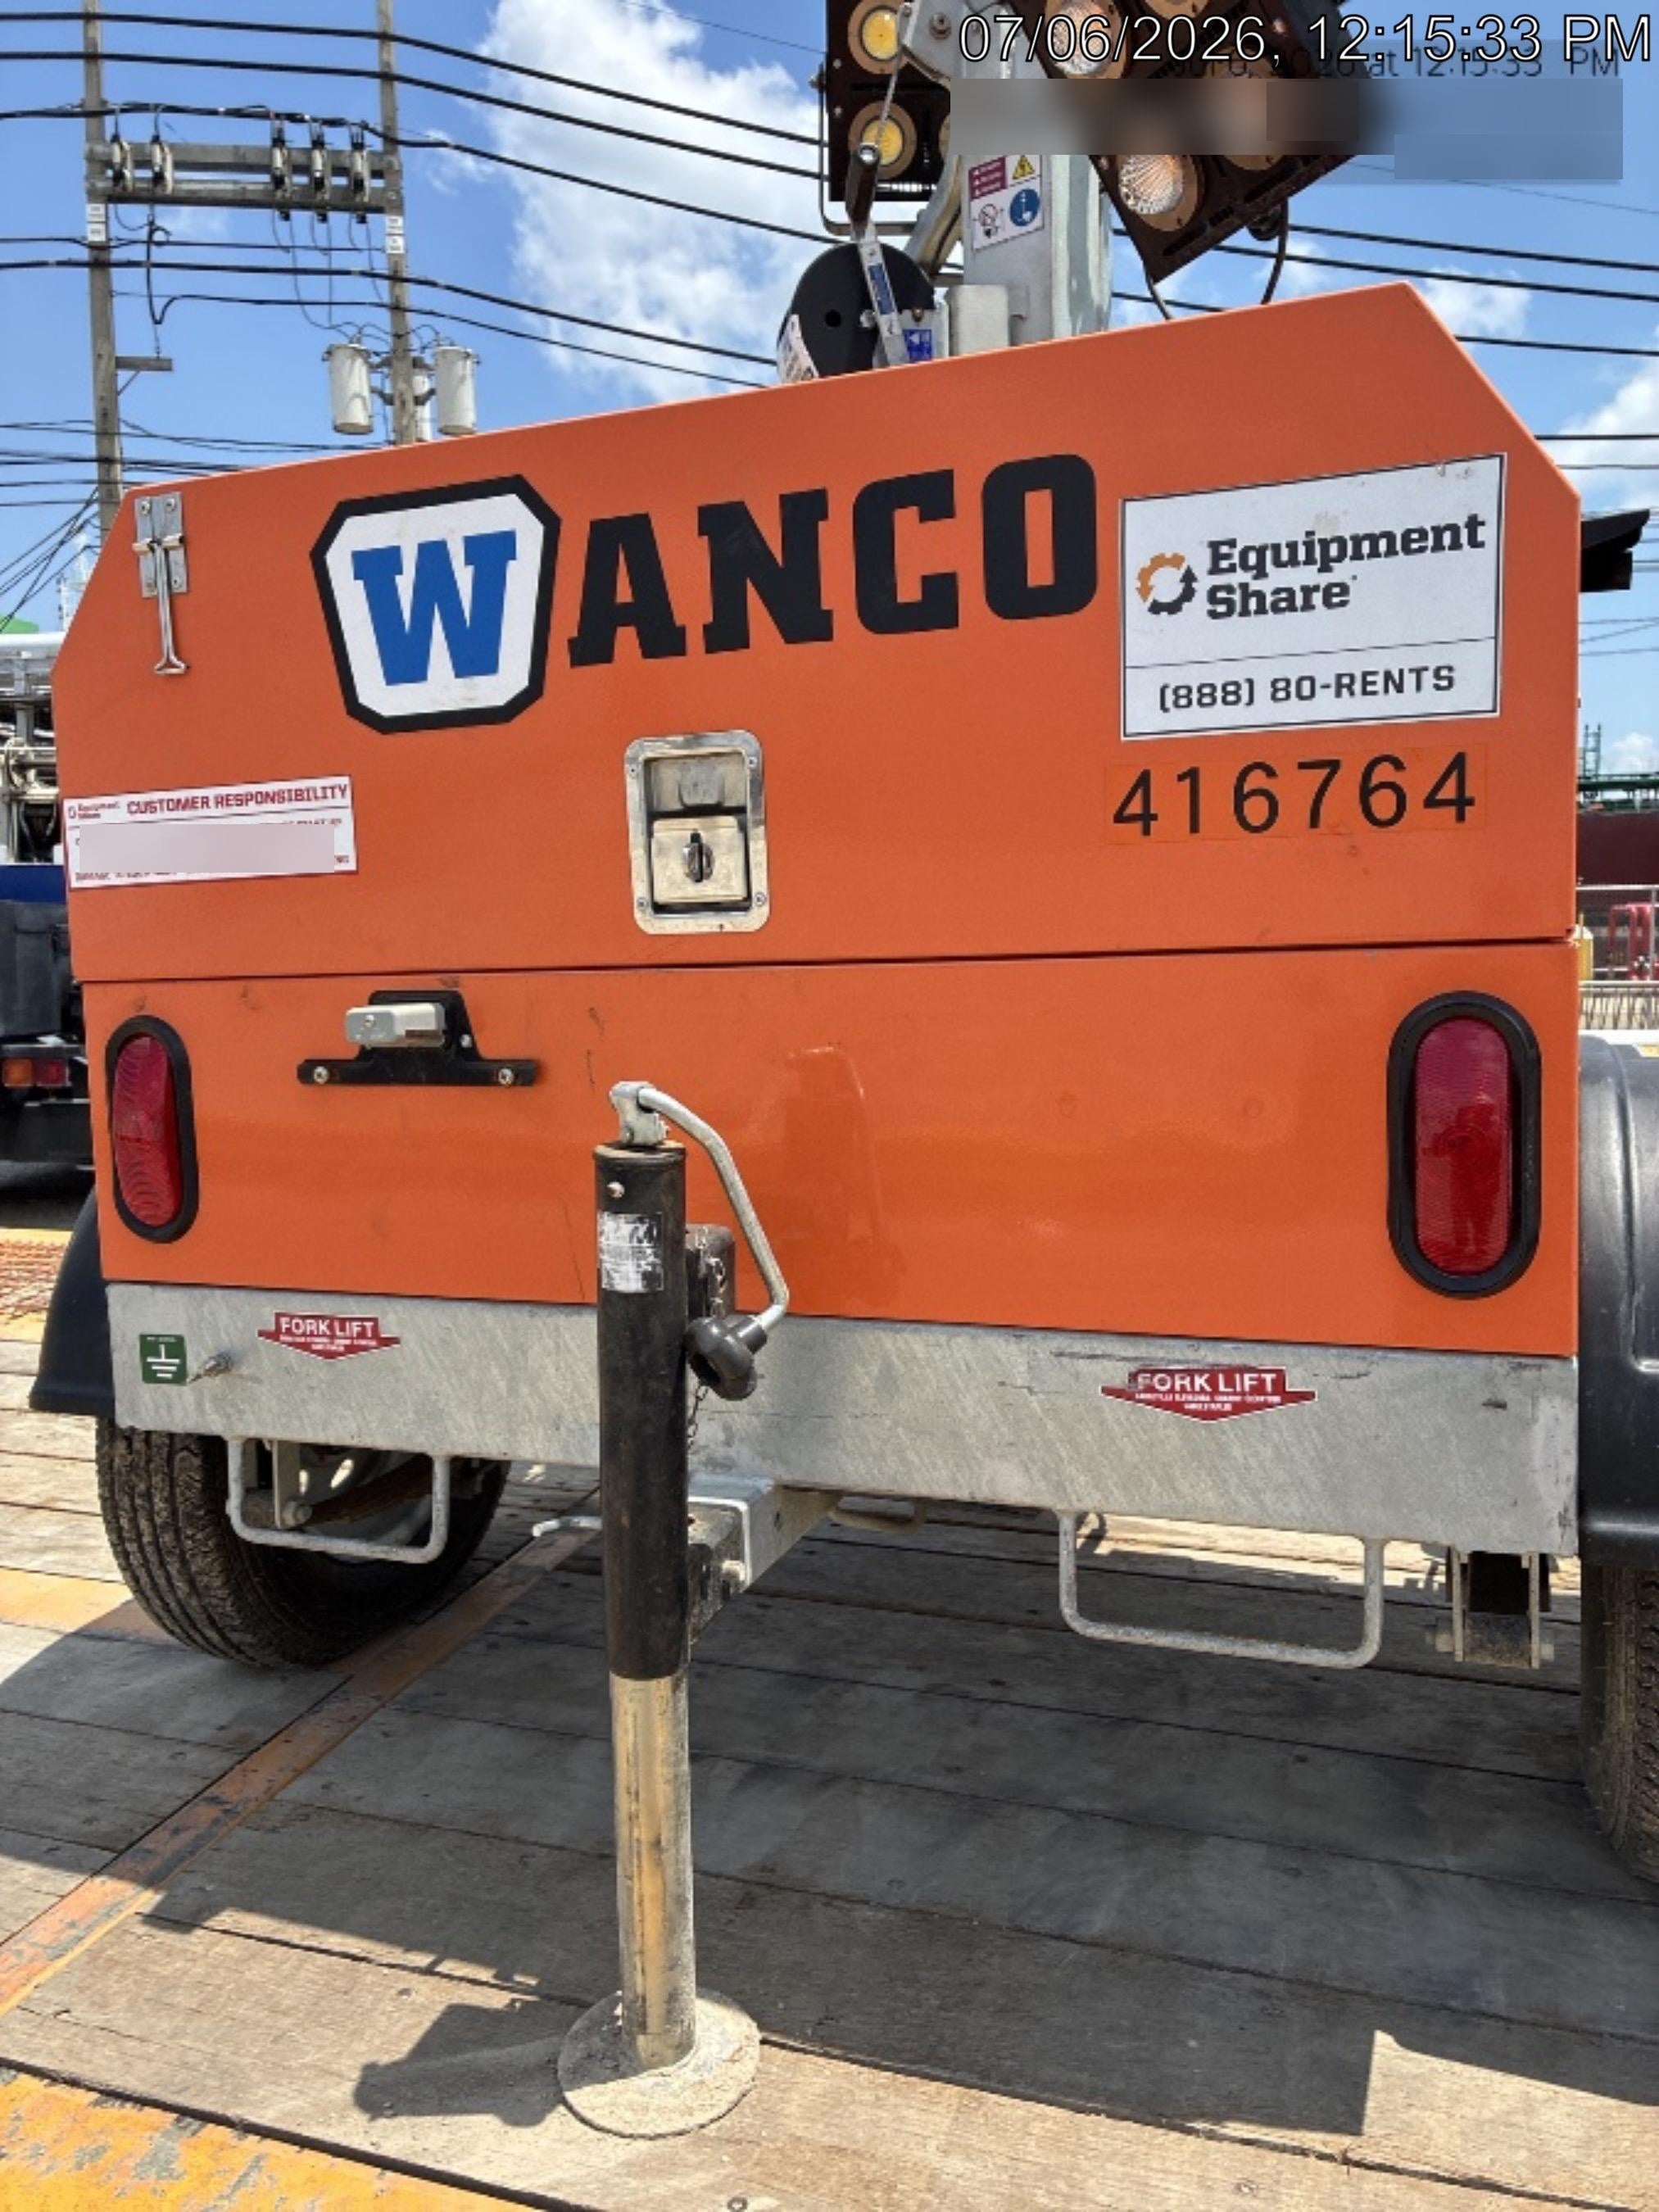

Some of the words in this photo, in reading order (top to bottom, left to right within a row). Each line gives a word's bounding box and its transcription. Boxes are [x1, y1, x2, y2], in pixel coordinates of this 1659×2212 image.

[1207, 512, 1486, 579] Equipment
[351, 453, 1098, 686] WANCO
[1207, 579, 1351, 619] Share
[1159, 678, 1255, 713] (888)
[1270, 664, 1456, 702] 80-RENTS
[127, 796, 211, 815] CUSTOMER
[215, 783, 348, 809] RESPONSIBILITY
[1113, 751, 1475, 836] 416764
[279, 1317, 330, 1335] FORK
[333, 1320, 374, 1338] LIFT
[1137, 1373, 1212, 1392] FORK
[1218, 1373, 1276, 1392] LIFT
